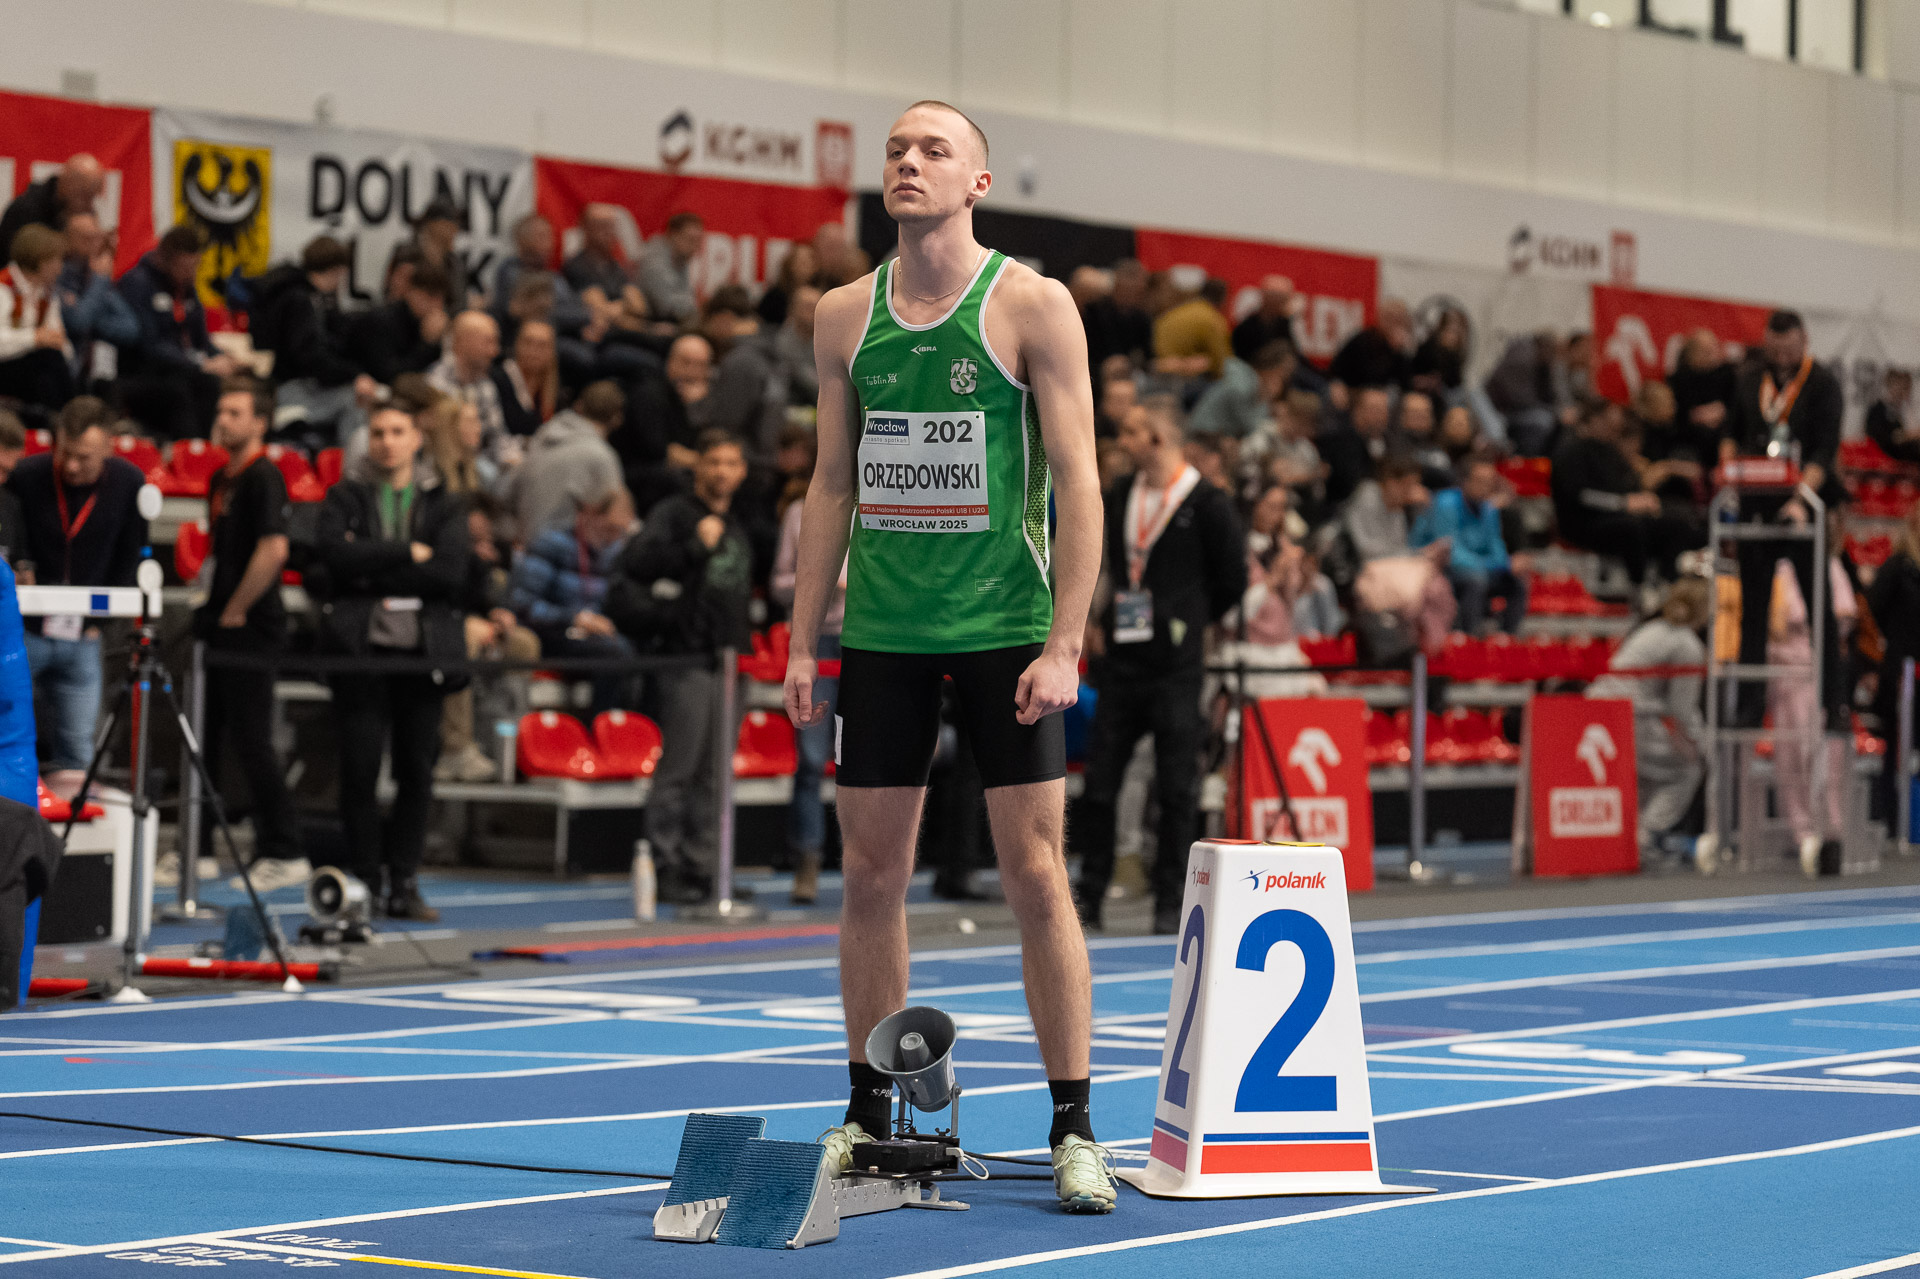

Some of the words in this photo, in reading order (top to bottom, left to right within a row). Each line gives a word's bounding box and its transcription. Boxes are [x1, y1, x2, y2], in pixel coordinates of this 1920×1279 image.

[867, 420, 906, 432] Wrocław
[923, 419, 973, 444] 202
[863, 462, 980, 495] ORZĘDOWSKI
[878, 518, 937, 530] WROCŁAW
[939, 520, 969, 529] 2025
[1265, 871, 1327, 893] polanik
[1164, 904, 1205, 1109] 2
[1234, 908, 1338, 1113] 2
